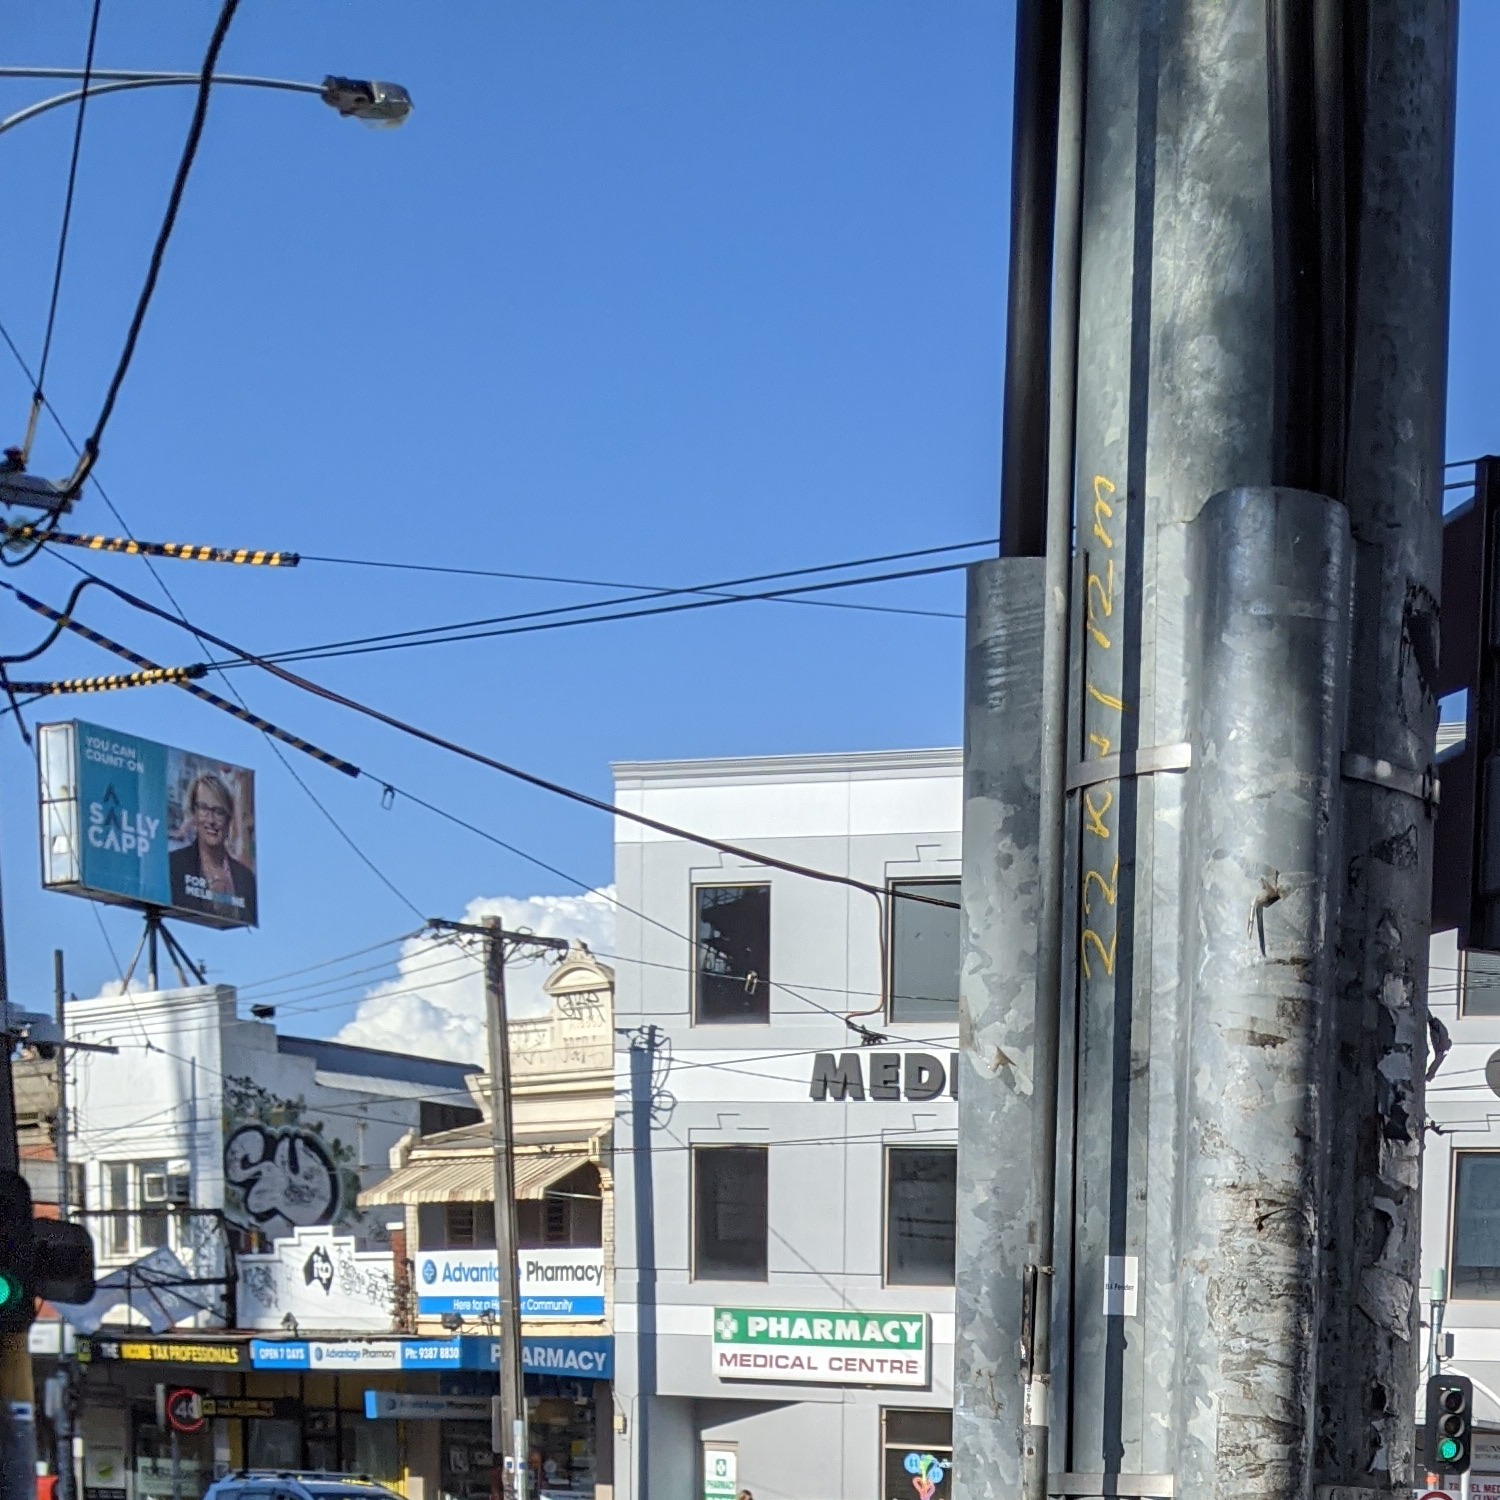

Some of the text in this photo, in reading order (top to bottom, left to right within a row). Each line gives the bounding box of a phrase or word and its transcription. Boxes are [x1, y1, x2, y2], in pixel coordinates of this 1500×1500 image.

[86, 737, 136, 757] YOU CAN
[84, 750, 144, 774] COUNT ON
[89, 801, 160, 839] SALLY
[88, 825, 150, 857] CAPP
[184, 874, 206, 887] FOR
[442, 1261, 604, 1286] Advanta Pharmacy
[453, 1299, 471, 1310] Here
[472, 1299, 483, 1310] for
[526, 1299, 573, 1312] Community
[747, 1316, 922, 1343] PHARMACY
[152, 1344, 169, 1361] TAX
[169, 1345, 239, 1364] PROFESSIONALS
[259, 1348, 305, 1360] OPEN 7 DAYS
[326, 1348, 396, 1360] Advantage Pharmacy
[490, 1343, 607, 1371] PARMACY
[719, 1353, 918, 1374] MEDICAL CENTRE
